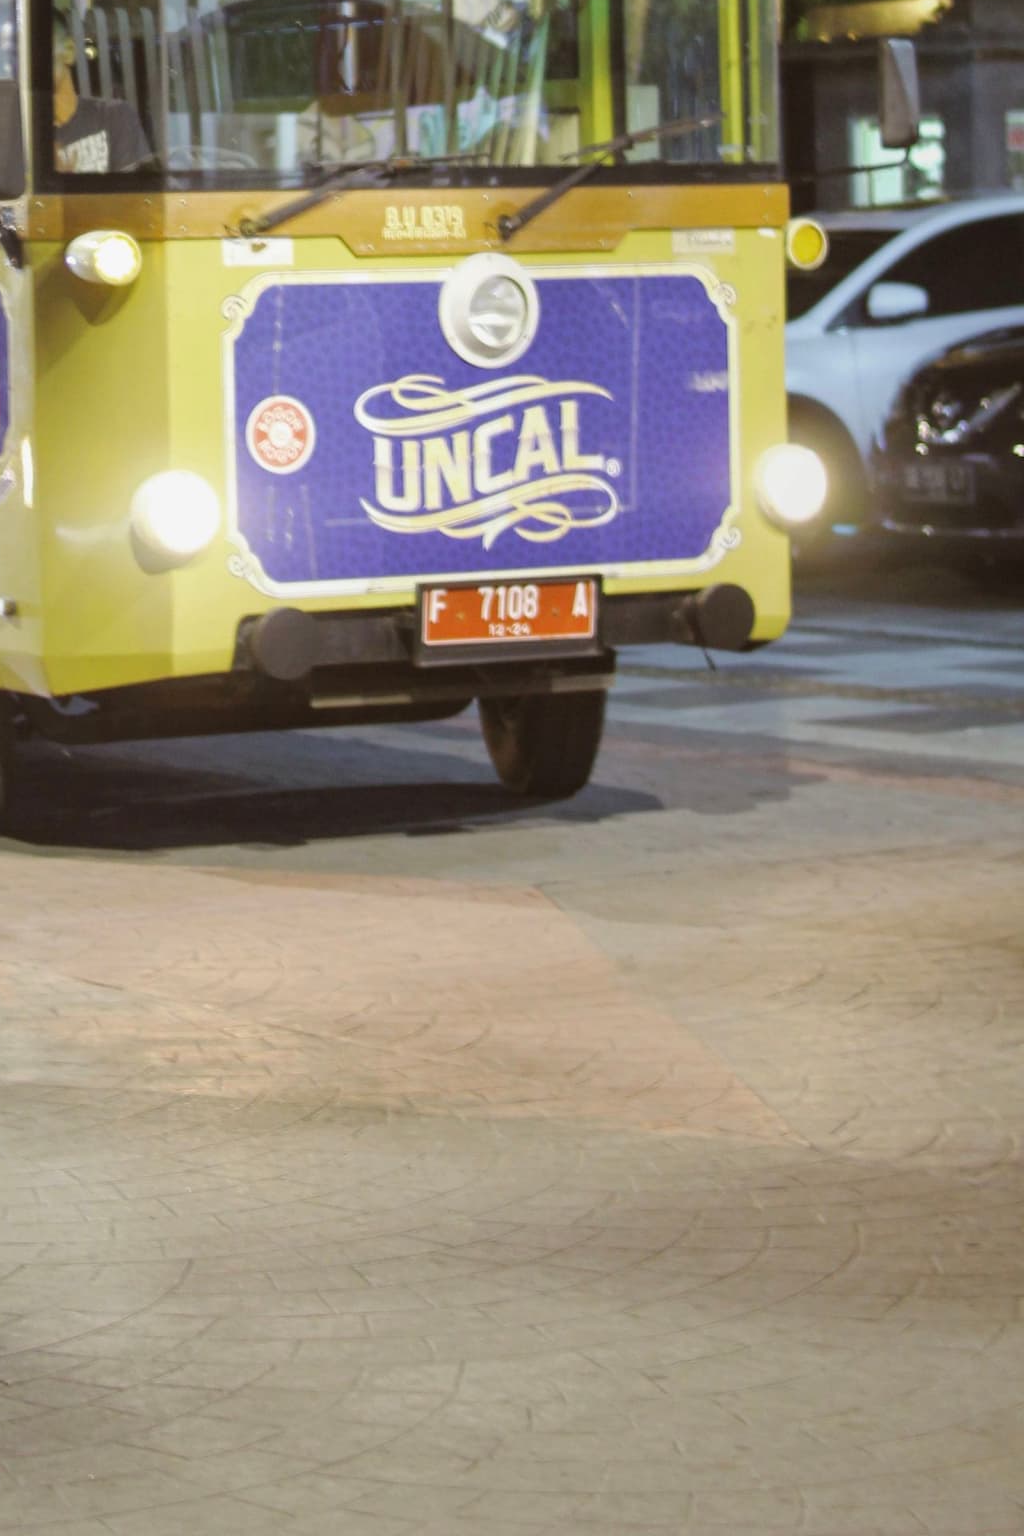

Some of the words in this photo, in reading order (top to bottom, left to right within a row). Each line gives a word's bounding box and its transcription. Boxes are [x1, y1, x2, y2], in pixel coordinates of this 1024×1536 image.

[373, 399, 606, 513] UNCAL
[429, 588, 448, 624] F
[478, 584, 540, 622] 7108
[571, 580, 588, 617] A
